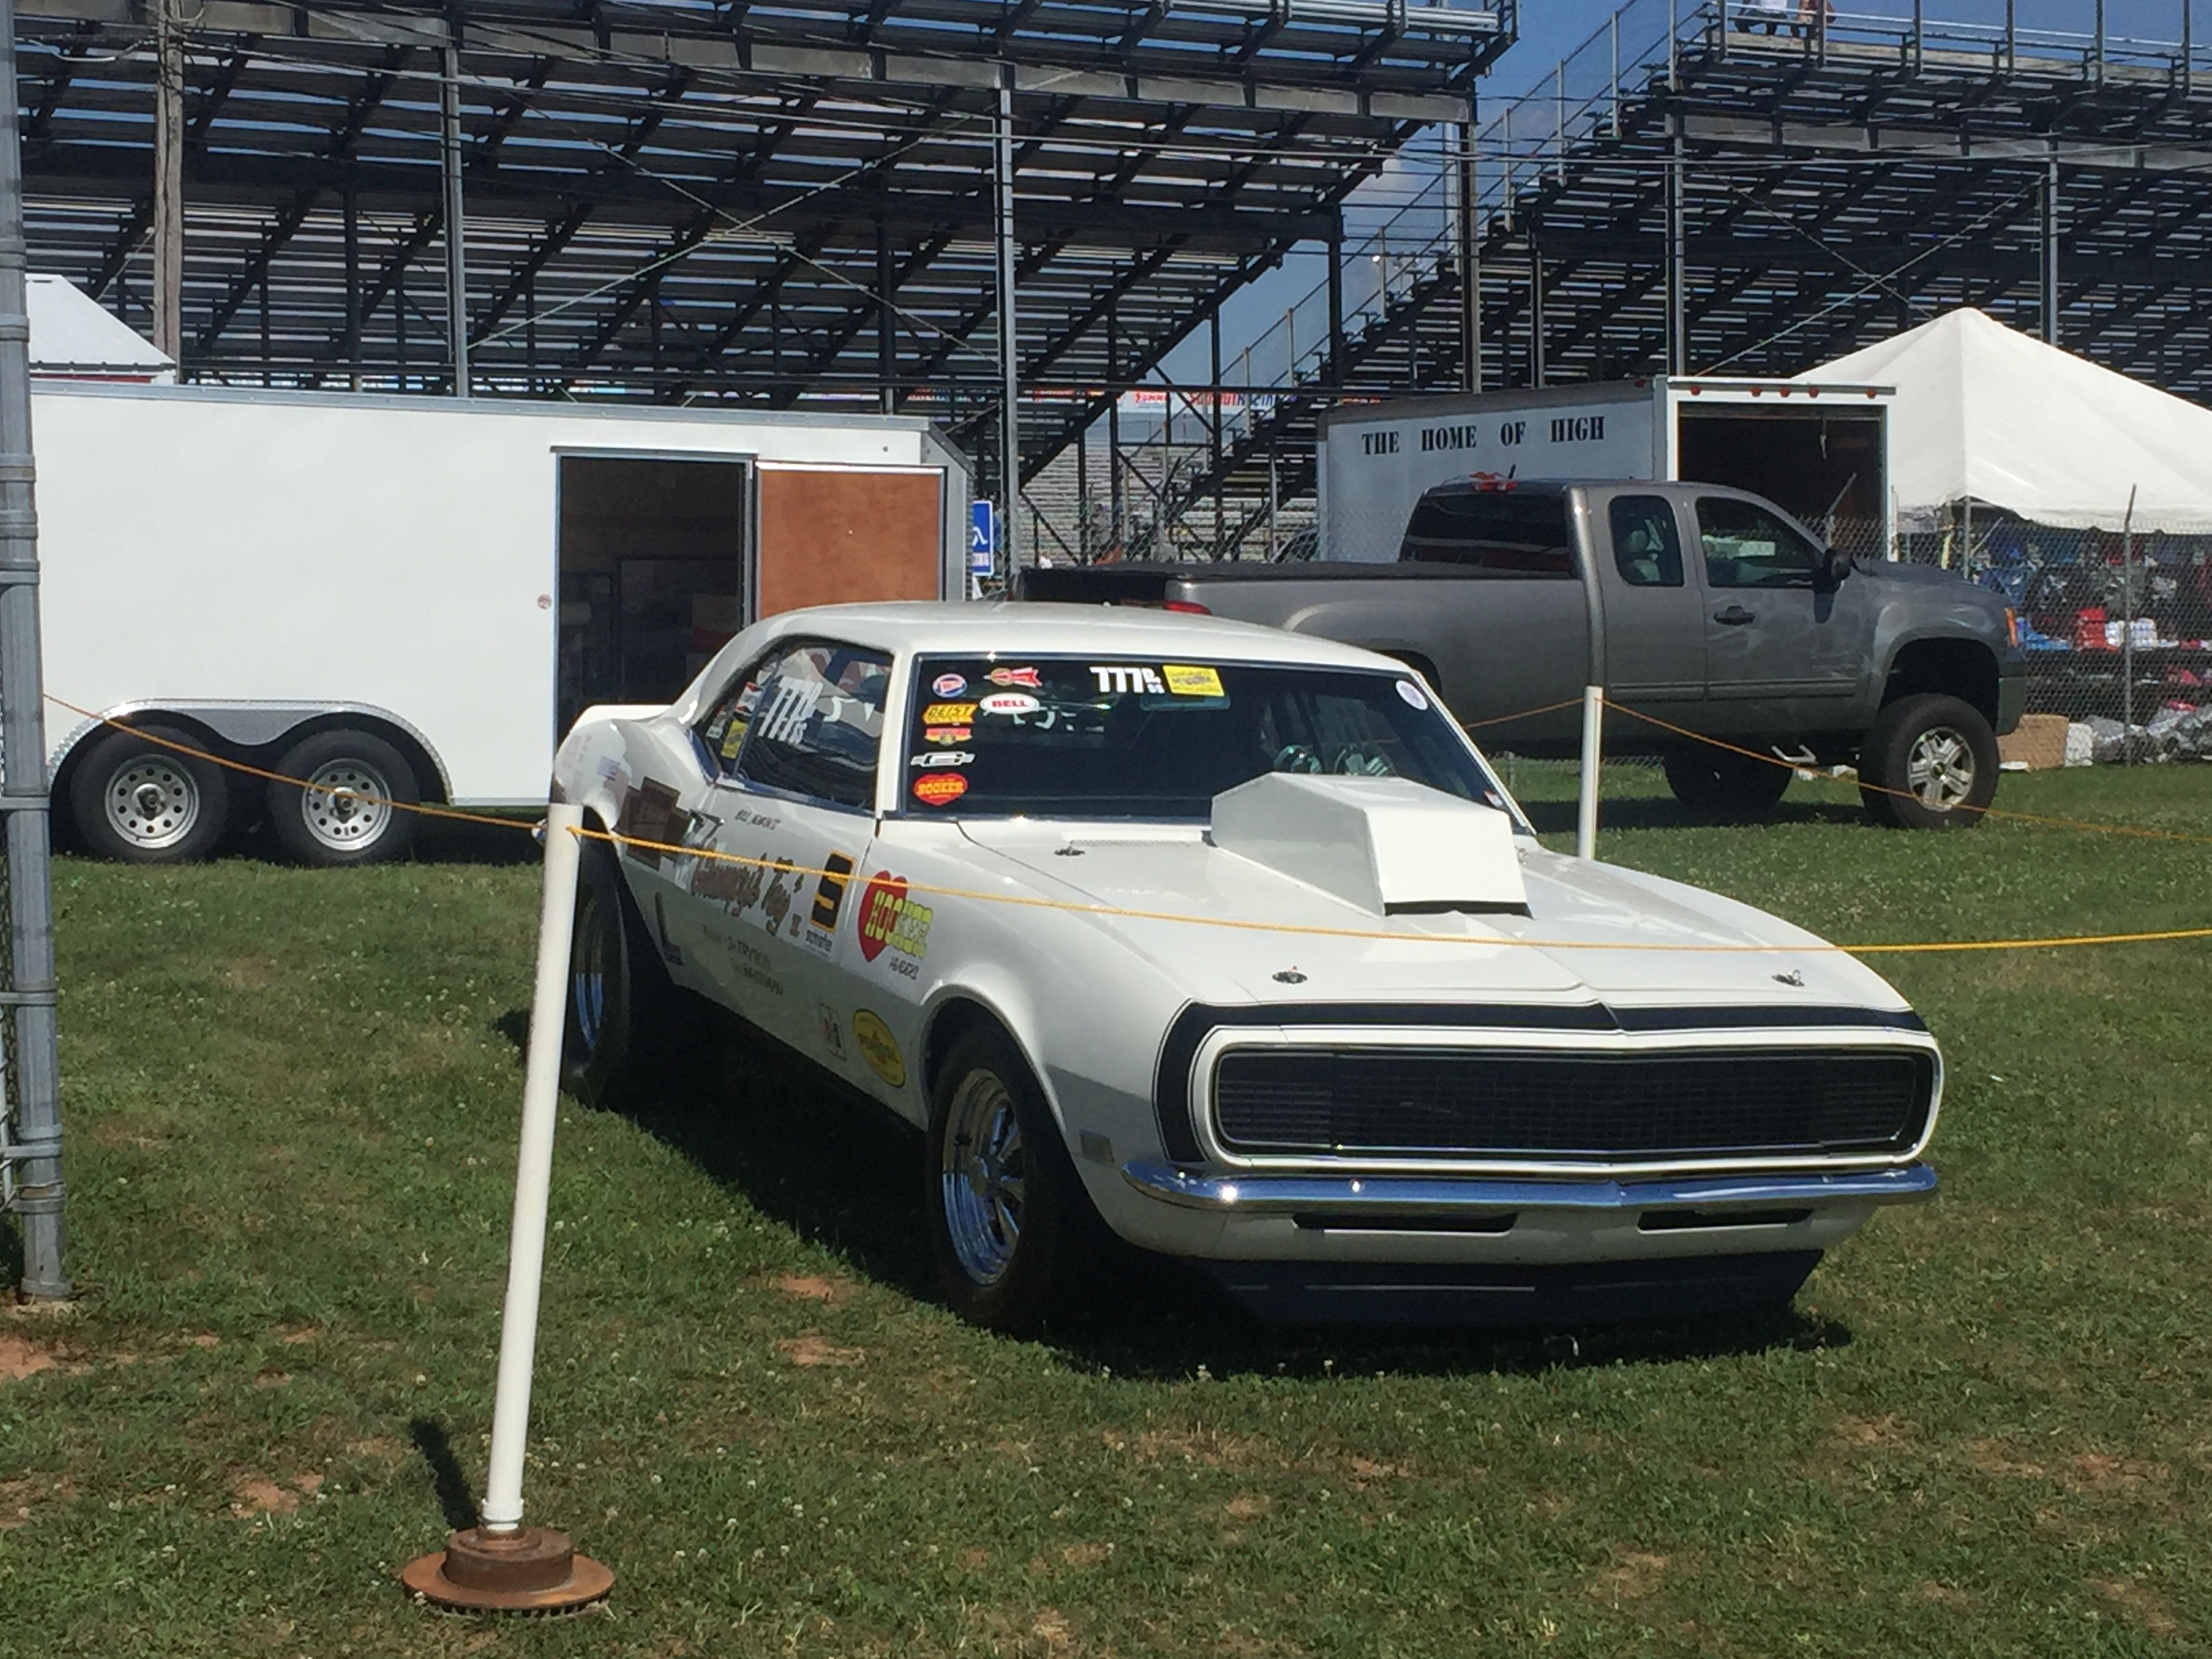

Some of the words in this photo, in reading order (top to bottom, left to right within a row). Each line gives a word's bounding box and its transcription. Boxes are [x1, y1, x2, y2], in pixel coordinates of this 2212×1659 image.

[1361, 431, 1399, 455] THE
[1421, 426, 1477, 452] HOME
[1500, 422, 1526, 447] OF
[1550, 416, 1605, 443] HIGH
[991, 699, 1028, 708] BELL
